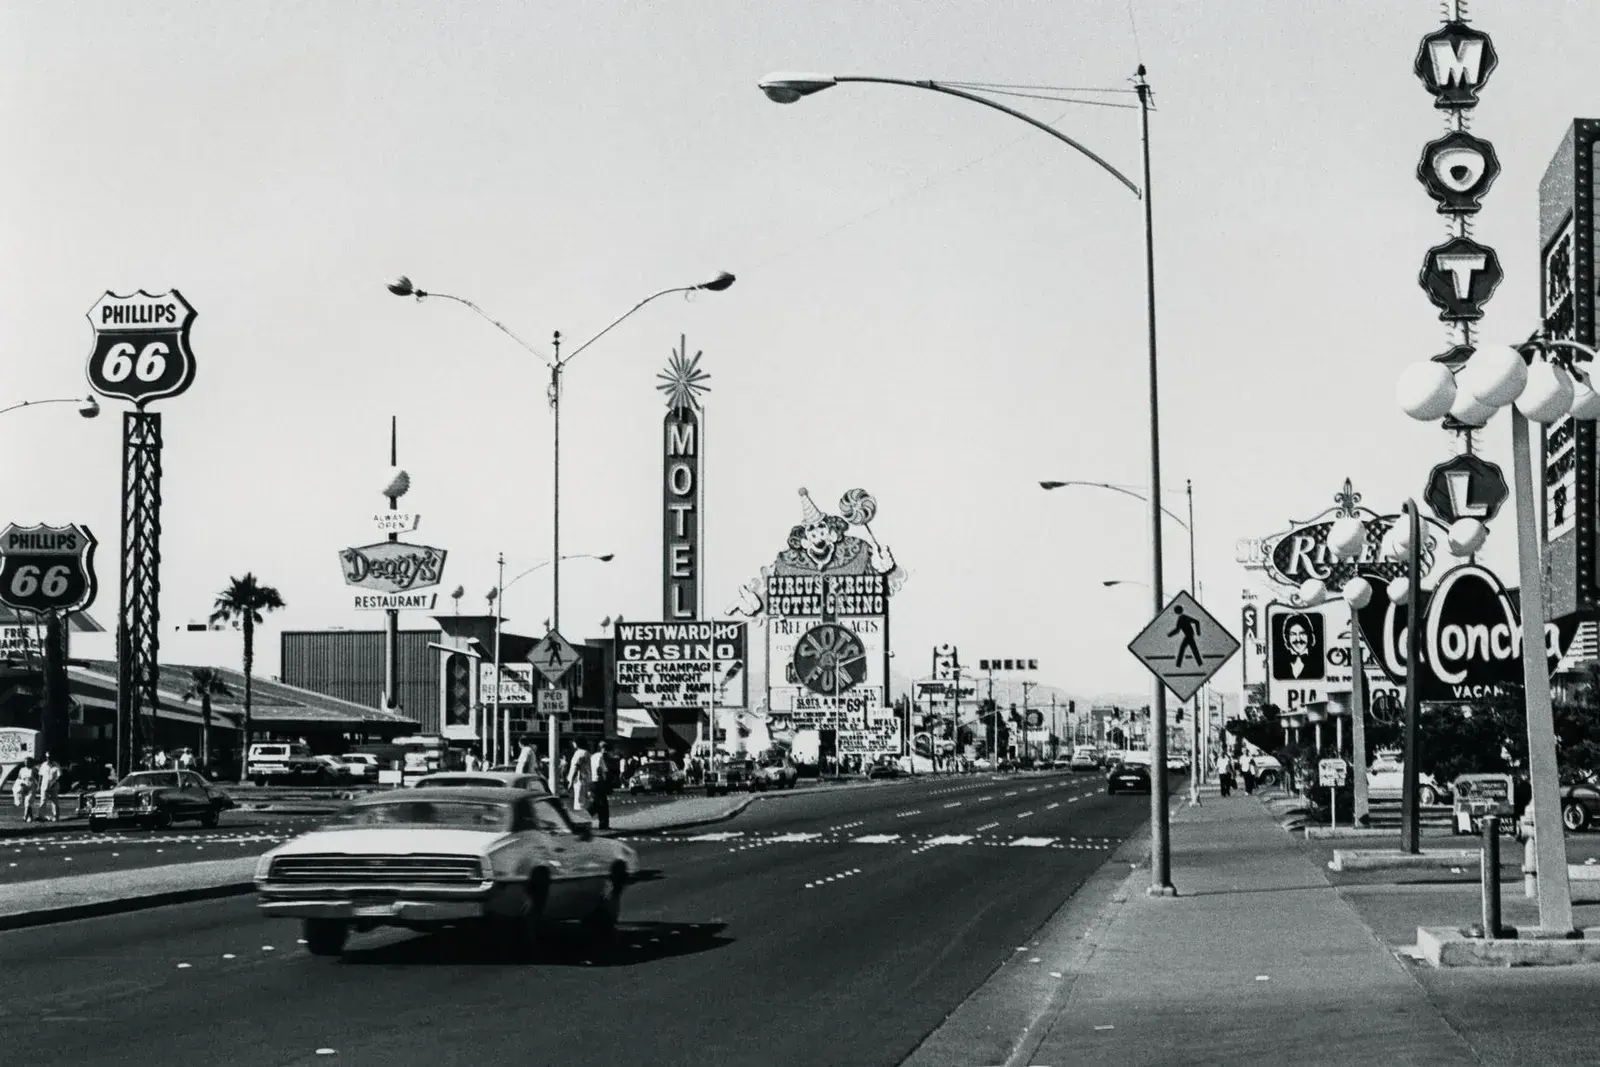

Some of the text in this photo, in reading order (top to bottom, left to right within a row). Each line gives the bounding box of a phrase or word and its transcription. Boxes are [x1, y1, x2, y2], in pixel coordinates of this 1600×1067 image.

[1428, 38, 1488, 517] MOTL
[102, 303, 176, 324] PHILLIPS
[101, 341, 169, 383] 66
[377, 521, 405, 530] OPEN
[667, 424, 694, 618] MOTEL
[8, 533, 77, 550] PHILLIPS
[344, 547, 438, 588] Denny's
[10, 564, 71, 597] 66
[769, 577, 883, 595] CIRCUS CIRCUS
[354, 596, 428, 608] RESTAURANT
[769, 595, 883, 615] HOTEL CASINO
[620, 624, 739, 641] WESTWARD HO
[623, 644, 735, 660] CASINO
[619, 663, 647, 673] FREE
[979, 659, 1037, 670] SHELL
[619, 673, 702, 683] PARTY TONIGHT
[544, 692, 563, 700] PED
[542, 701, 565, 710] XING
